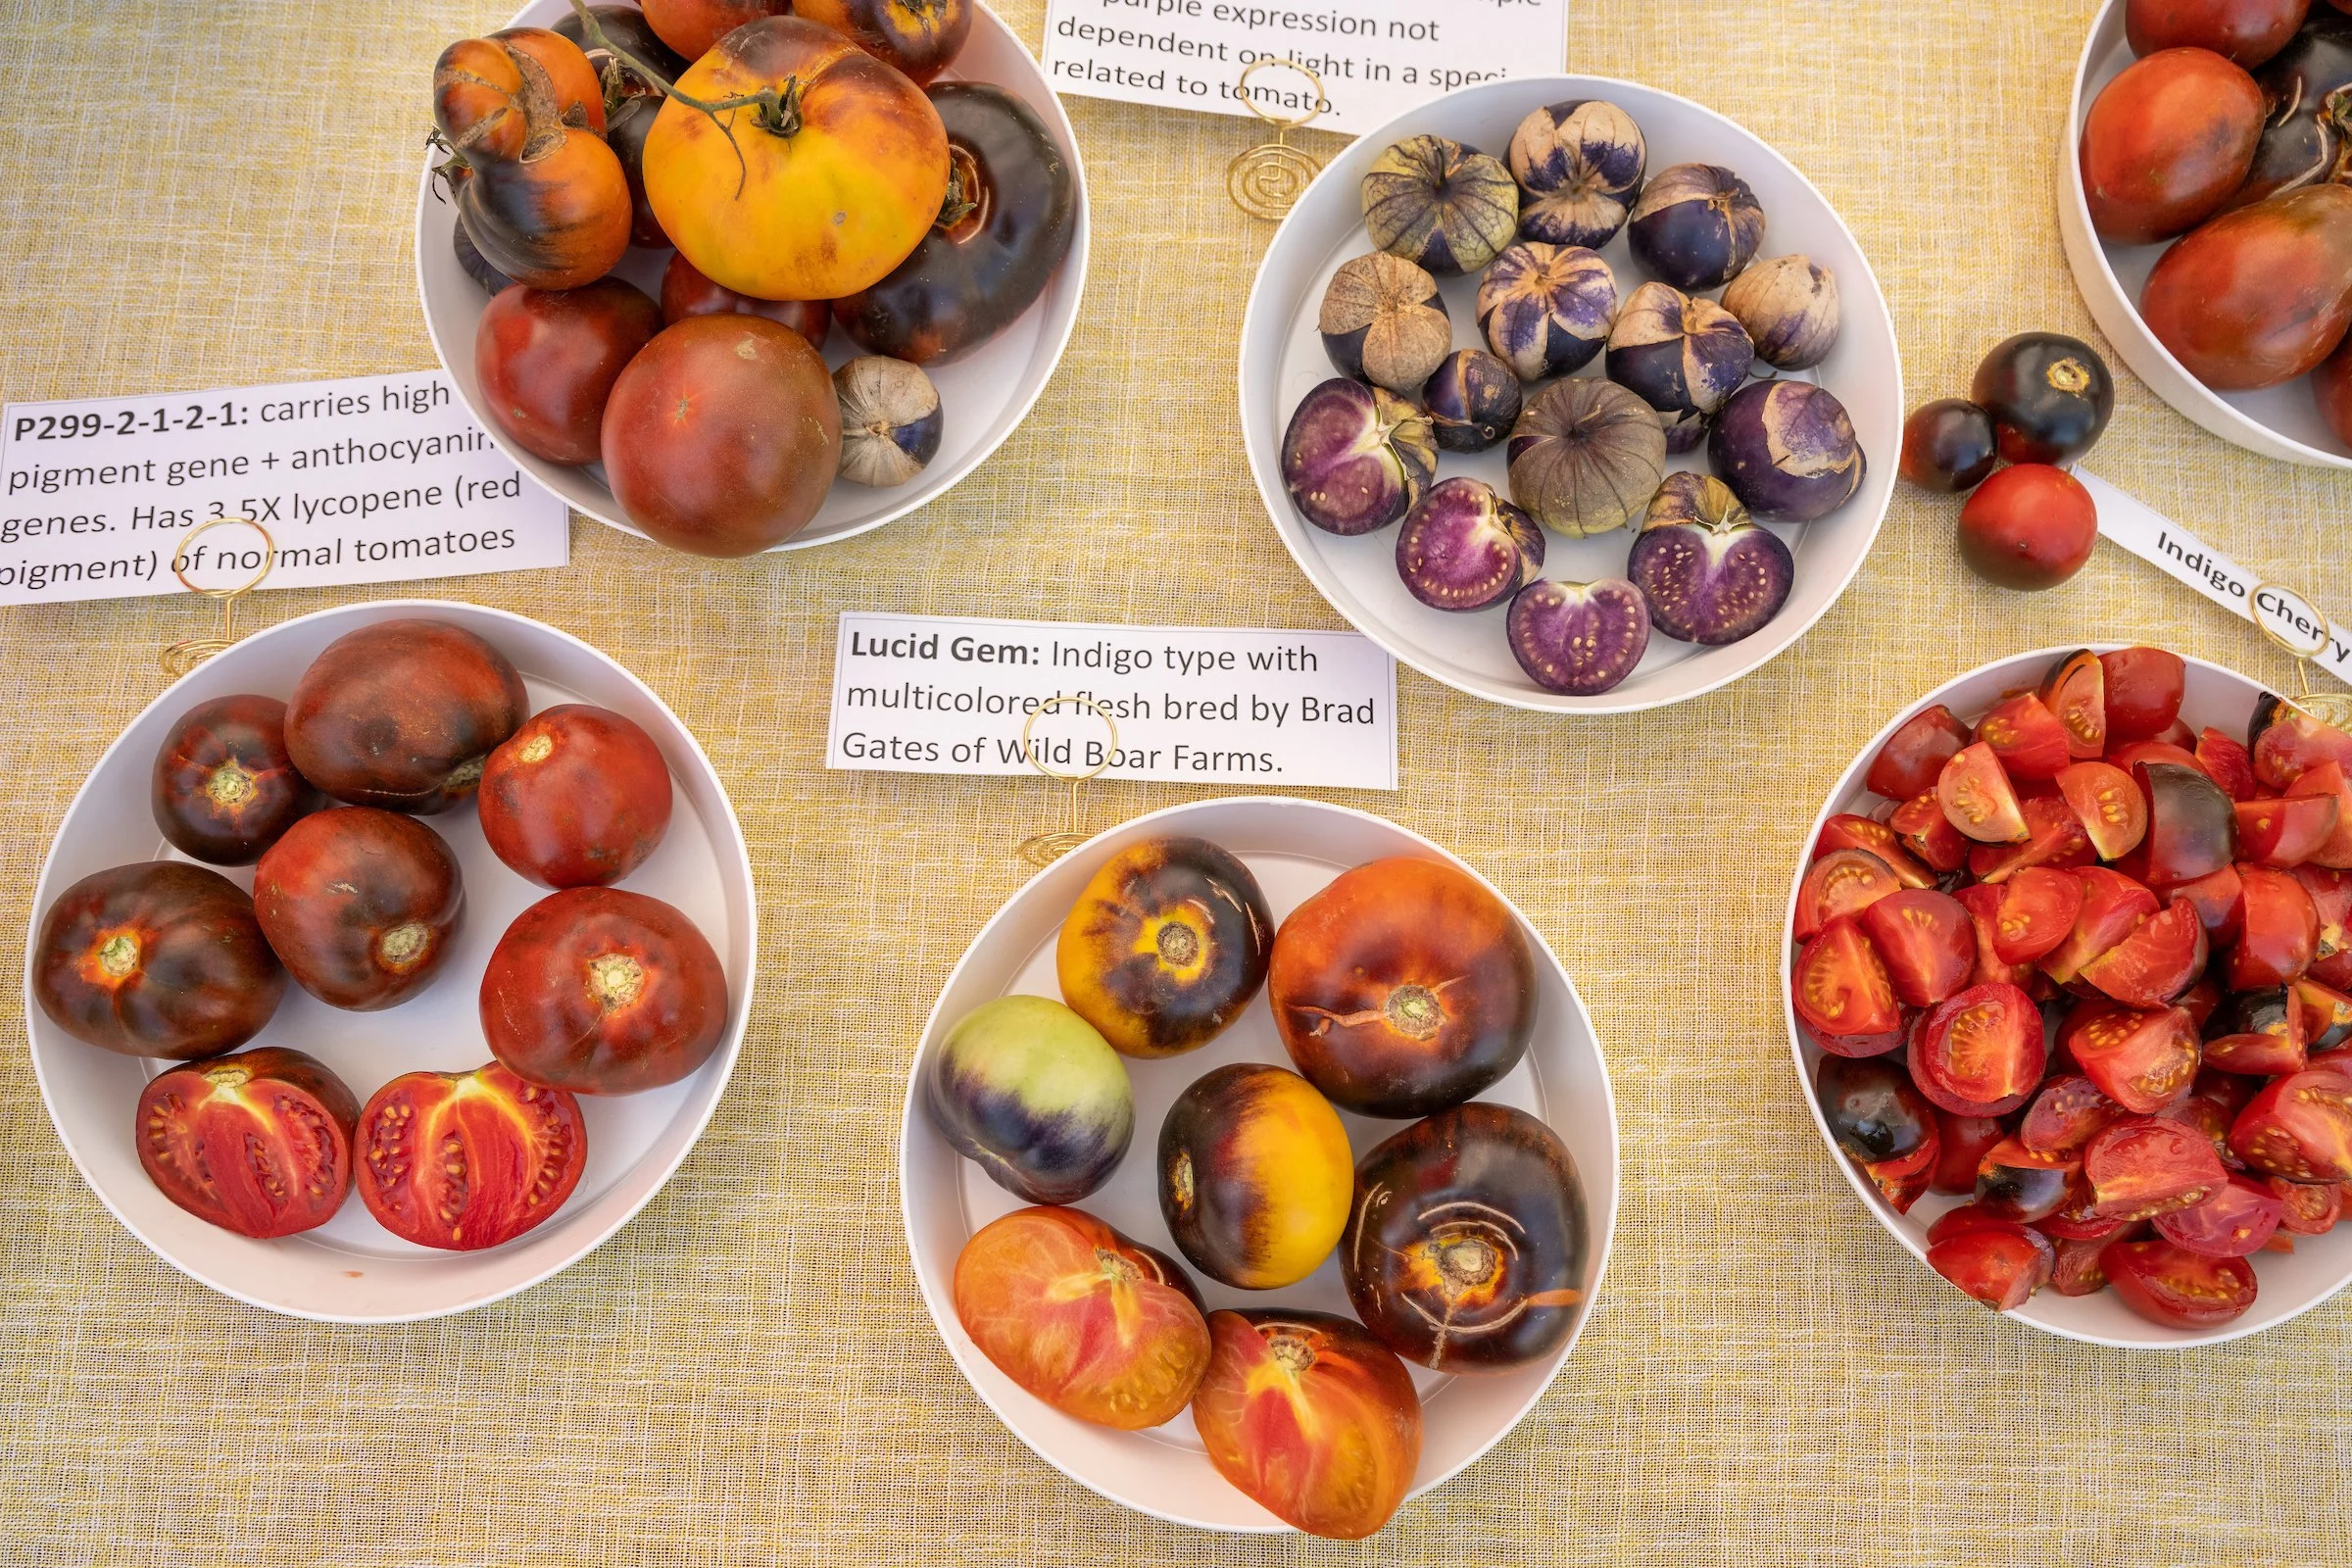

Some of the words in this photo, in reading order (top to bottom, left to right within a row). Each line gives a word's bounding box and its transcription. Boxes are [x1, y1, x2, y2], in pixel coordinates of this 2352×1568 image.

[1213, 4, 1377, 36] expression
[1389, 20, 1441, 41] not
[1057, 16, 1228, 62] dependent
[1239, 49, 1276, 67] on
[1289, 49, 1355, 79] light
[1365, 58, 1391, 81] in
[1402, 66, 1418, 84] a
[1054, 59, 1165, 91] related
[1176, 74, 1208, 96] to
[1219, 80, 1341, 116] tomato.
[15, 401, 248, 442] P299-2-1-2-1:
[261, 391, 370, 422] carries
[382, 380, 450, 414] high
[9, 459, 157, 496] pigment
[167, 455, 250, 487] gene
[261, 452, 280, 470] +
[1, 513, 116, 544] genes.
[131, 506, 194, 530] Has
[207, 496, 281, 523] 35X
[293, 485, 443, 524] lycopene
[455, 470, 520, 509] (red
[172, 545, 208, 573] of
[354, 527, 515, 563] tomatoes
[2157, 531, 2245, 598] Indigo
[2257, 592, 2351, 663] Chery
[852, 631, 938, 660] Lucid
[951, 636, 1039, 666] Gem:
[1053, 641, 1152, 675] Indigo
[1163, 646, 1236, 676] type
[1247, 645, 1318, 672] with
[848, 682, 1060, 714] multicolored
[1075, 690, 1151, 719] flesh
[1164, 693, 1239, 721] bred
[1251, 694, 1290, 728] by
[1301, 696, 1375, 725] Brad
[843, 732, 939, 761] Gates
[952, 737, 987, 764] of
[997, 737, 1071, 764] Wild
[1085, 741, 1162, 769] Boar
[1173, 744, 1283, 773] Farms.
